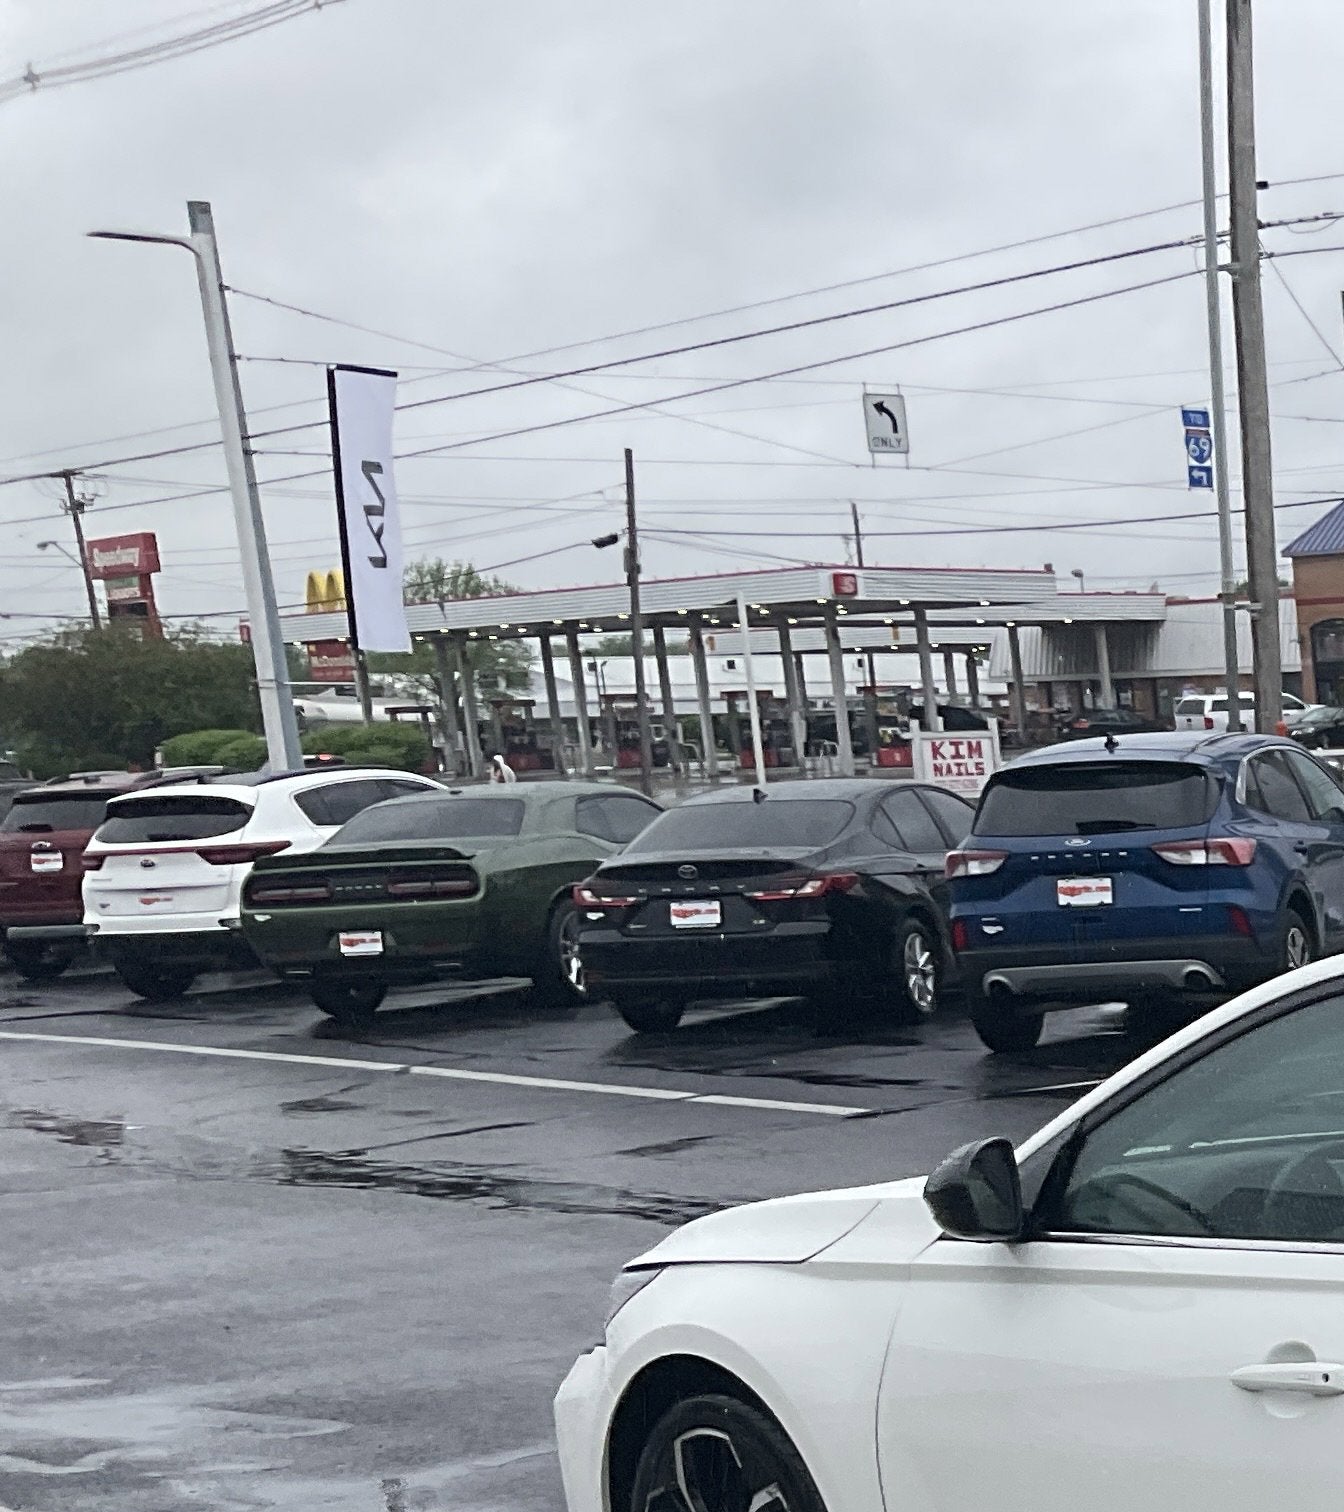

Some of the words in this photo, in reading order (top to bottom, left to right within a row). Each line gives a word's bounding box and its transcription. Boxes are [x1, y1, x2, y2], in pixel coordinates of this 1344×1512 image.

[872, 437, 902, 448] ONLY
[1189, 438, 1209, 458] 69
[931, 741, 983, 760] KIM
[933, 762, 985, 776] NAILS
